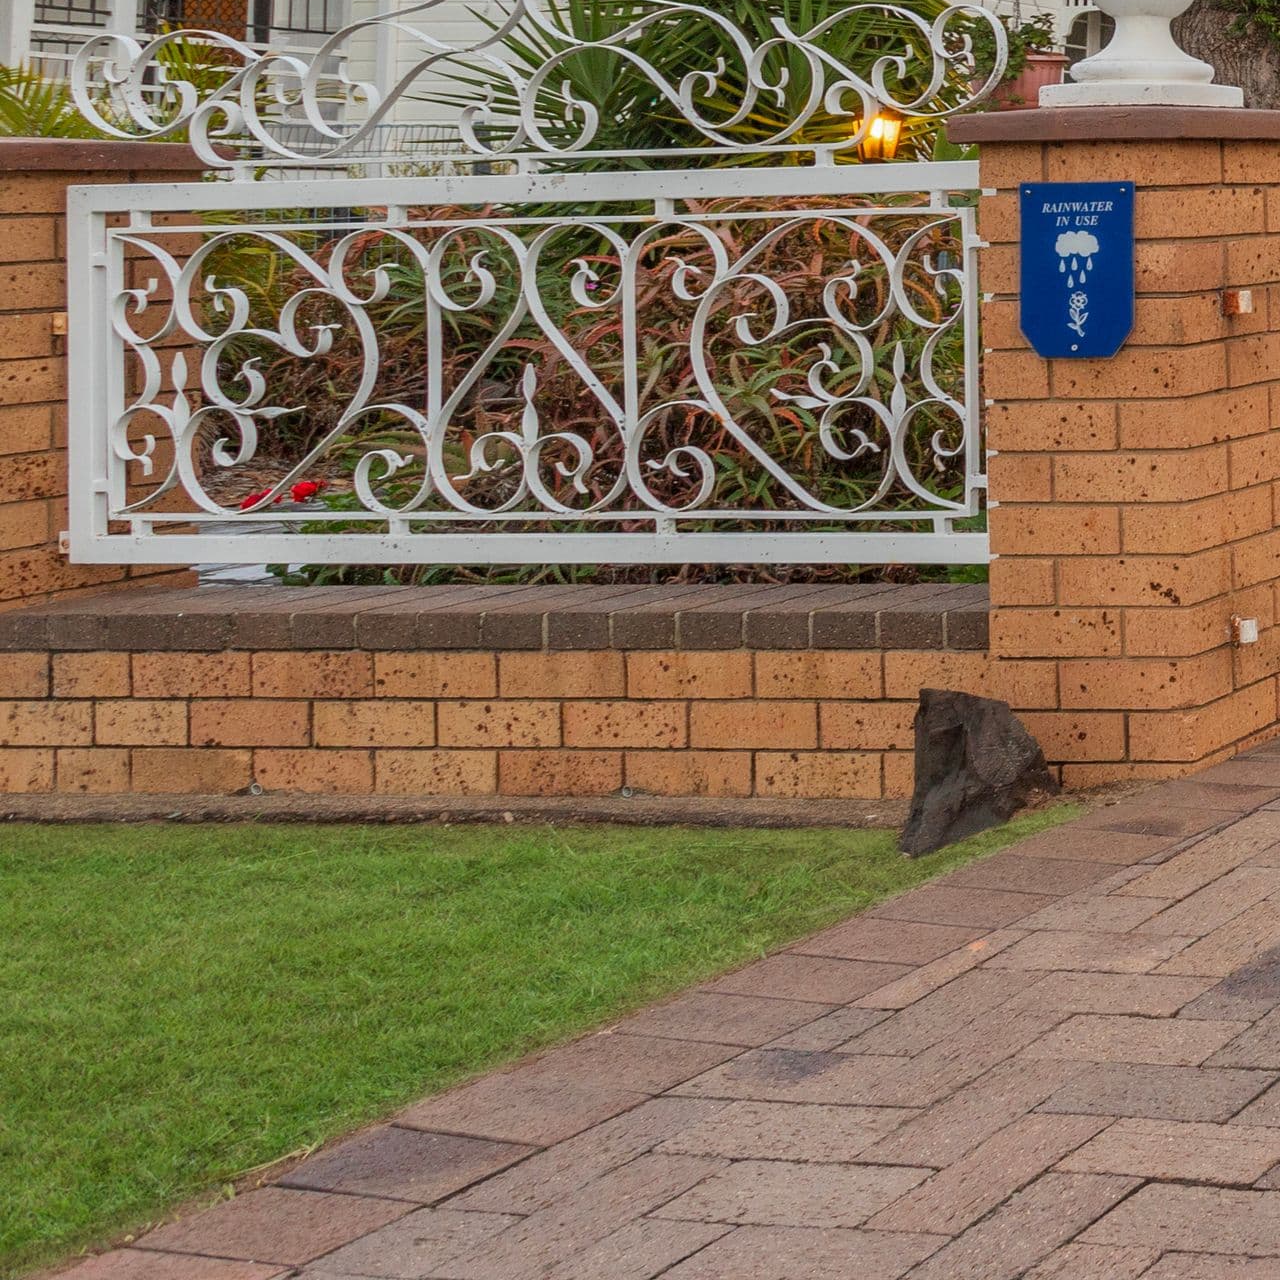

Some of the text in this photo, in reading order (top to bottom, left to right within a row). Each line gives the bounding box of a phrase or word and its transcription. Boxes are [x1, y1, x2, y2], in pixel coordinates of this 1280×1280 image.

[1042, 201, 1113, 213] RAINWATER
[1056, 215, 1099, 226] IN USE
